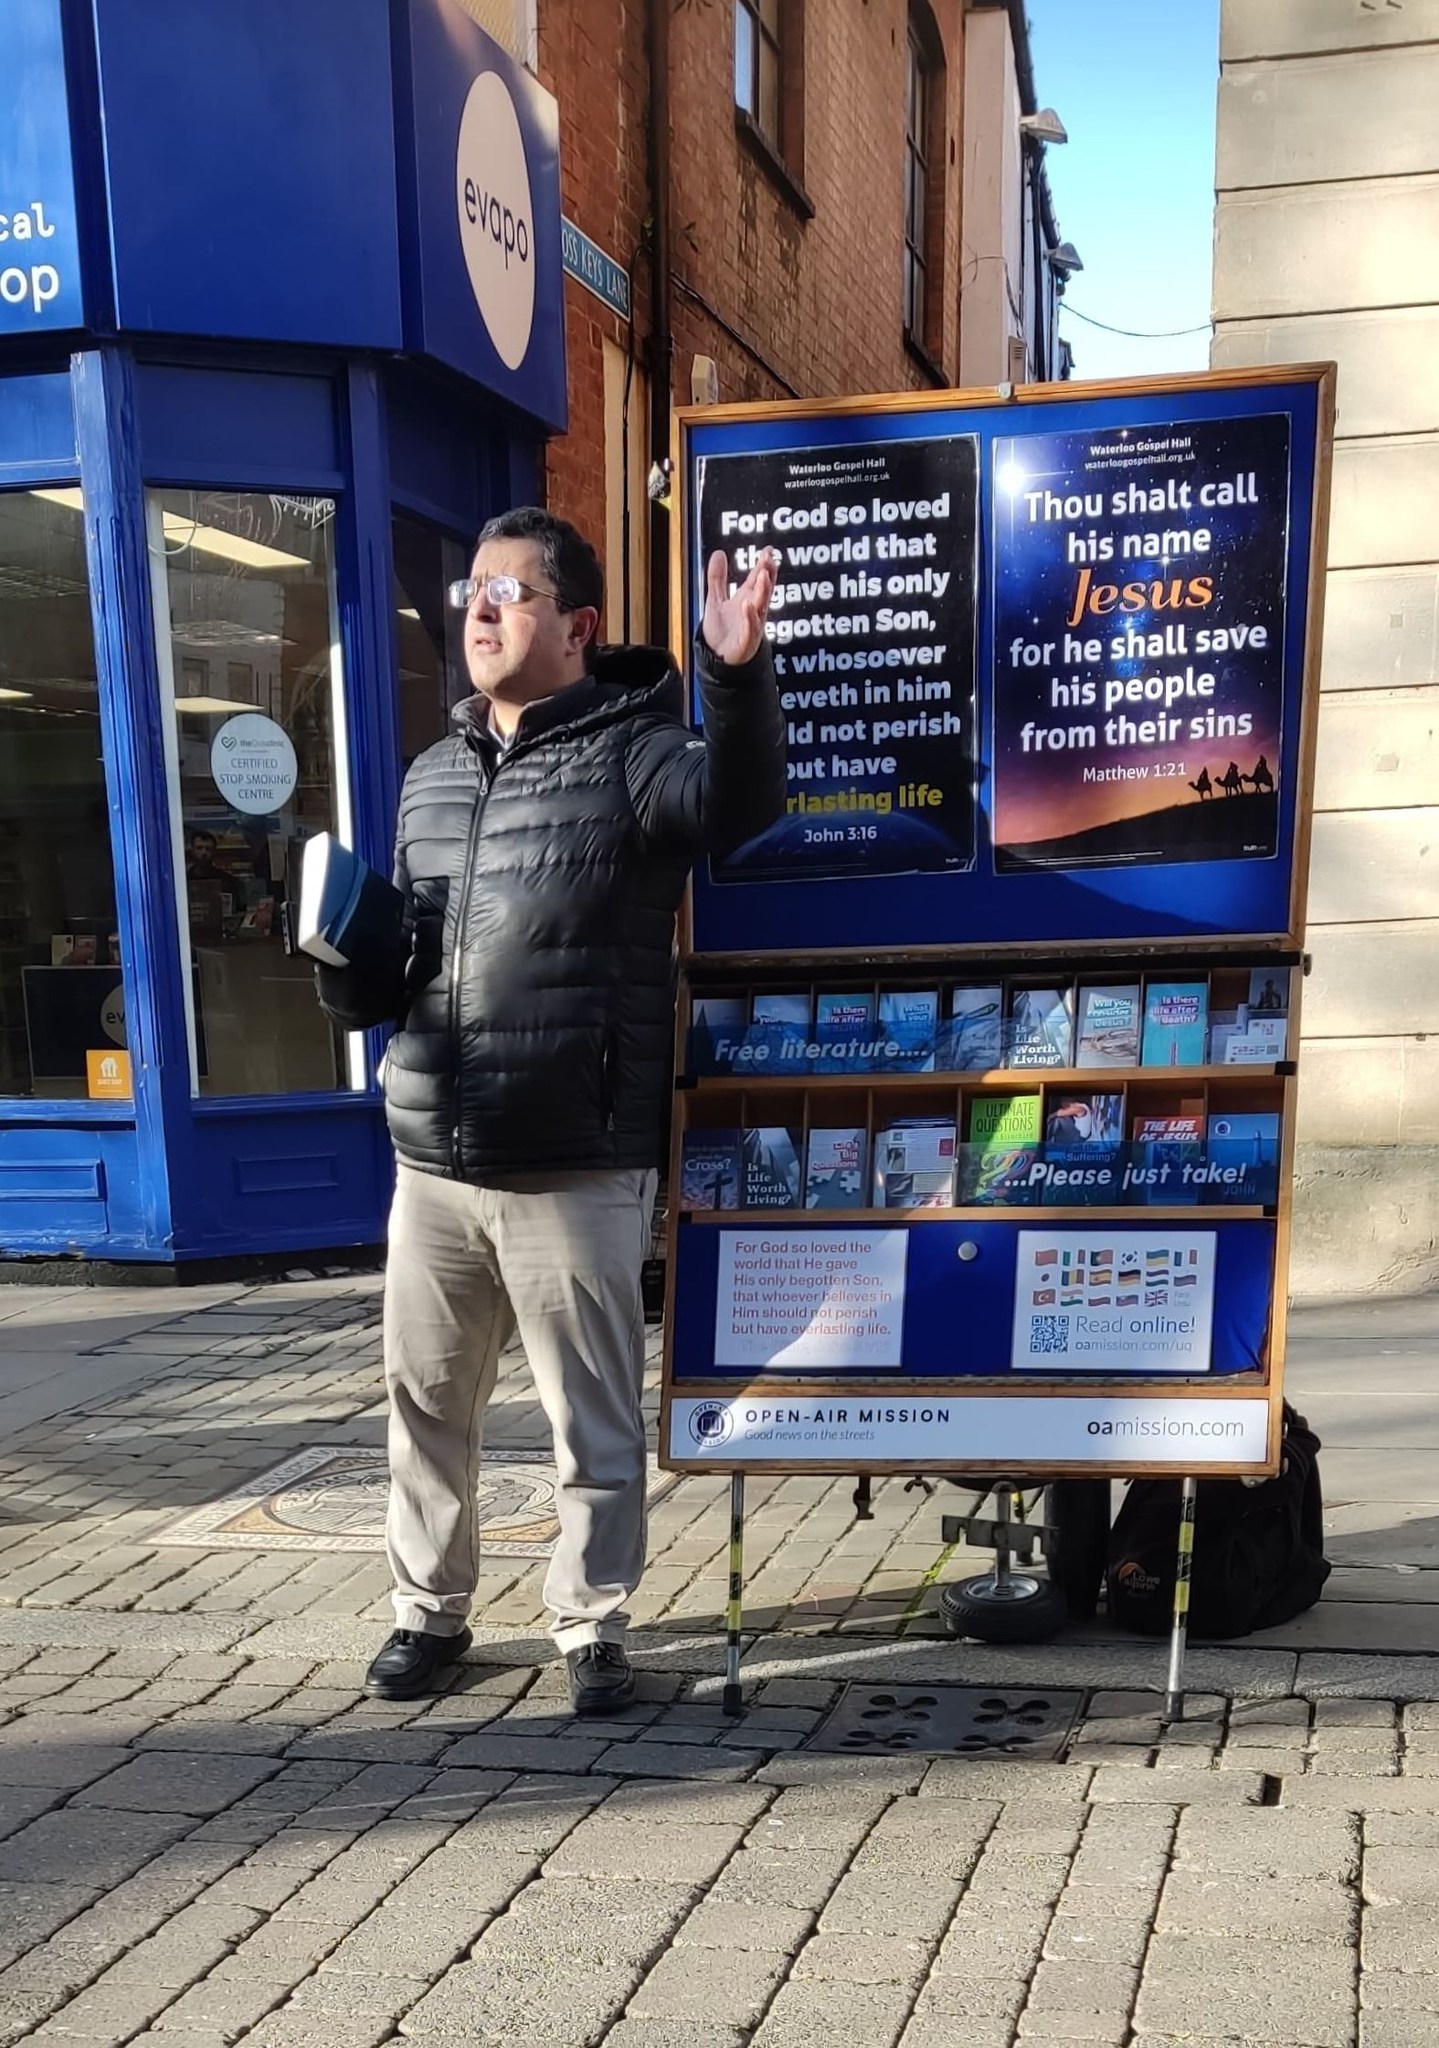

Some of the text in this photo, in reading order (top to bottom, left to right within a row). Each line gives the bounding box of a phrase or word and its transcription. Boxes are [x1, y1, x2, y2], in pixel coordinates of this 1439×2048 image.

[464, 177, 528, 270] evapo
[581, 241, 603, 287] KEYS
[606, 265, 628, 309] LANE
[0, 264, 59, 313] op
[1090, 437, 1191, 456] Waterloo Gospel Hall
[789, 457, 886, 475] Waterloo Gospel Hall
[1085, 451, 1196, 471] waterloogospelhall.org.uk
[784, 472, 890, 489] waterloogospelhall.org.uk
[1023, 472, 1259, 522] Thou shalt call
[721, 492, 950, 535] For God so loved
[787, 535, 870, 566] world
[875, 532, 937, 559] that
[1067, 528, 1212, 563] his name
[768, 579, 834, 610] gave
[839, 570, 882, 598] his
[886, 567, 951, 598] only
[1066, 567, 1213, 627] Jesus
[875, 607, 936, 632] Son,
[1009, 623, 1268, 668] for he shall save
[792, 644, 947, 674] whosoever
[776, 675, 951, 710] eveth in him
[1051, 667, 1216, 712] his people
[820, 719, 867, 743] not
[872, 711, 961, 745] perish
[1020, 708, 1253, 752] from their sins
[231, 758, 278, 769] CERTIFIED
[832, 754, 897, 779] have
[1083, 761, 1186, 783] Matthew 1:21
[219, 774, 291, 785] STOP SMOKING
[238, 789, 274, 799] CENTRE
[899, 783, 944, 809] life
[803, 825, 878, 844] John 3:16
[715, 1039, 770, 1061] Free
[1016, 1044, 1056, 1054] Worth
[1013, 1055, 1061, 1065] Living?
[986, 1101, 1035, 1116] ULTIMATE
[976, 1116, 1033, 1133] QUESTIONS
[1143, 1120, 1197, 1131] THE LIFE
[685, 1158, 731, 1172] Cross?
[748, 1163, 758, 1172] Is
[747, 1173, 771, 1182] Life
[1123, 1162, 1171, 1190] just
[1183, 1162, 1247, 1184] take!
[747, 1183, 786, 1193] Worth
[747, 1195, 791, 1205] Living?
[735, 1241, 871, 1254] For God so loved the
[734, 1257, 858, 1272] world that He gave
[733, 1273, 755, 1286] His
[758, 1274, 786, 1288] only
[789, 1274, 850, 1288] begotten
[733, 1290, 892, 1303] that whoever believes in
[732, 1306, 878, 1320] Him should not perish
[732, 1322, 891, 1337] but have everlasting life.
[1076, 1316, 1196, 1333] Read online!
[1075, 1339, 1192, 1353] oamission.com/uq
[745, 1409, 950, 1423] OPEN-AIR MISSION
[744, 1428, 876, 1440] Good news on the streets
[1087, 1416, 1244, 1436] oamission.com
